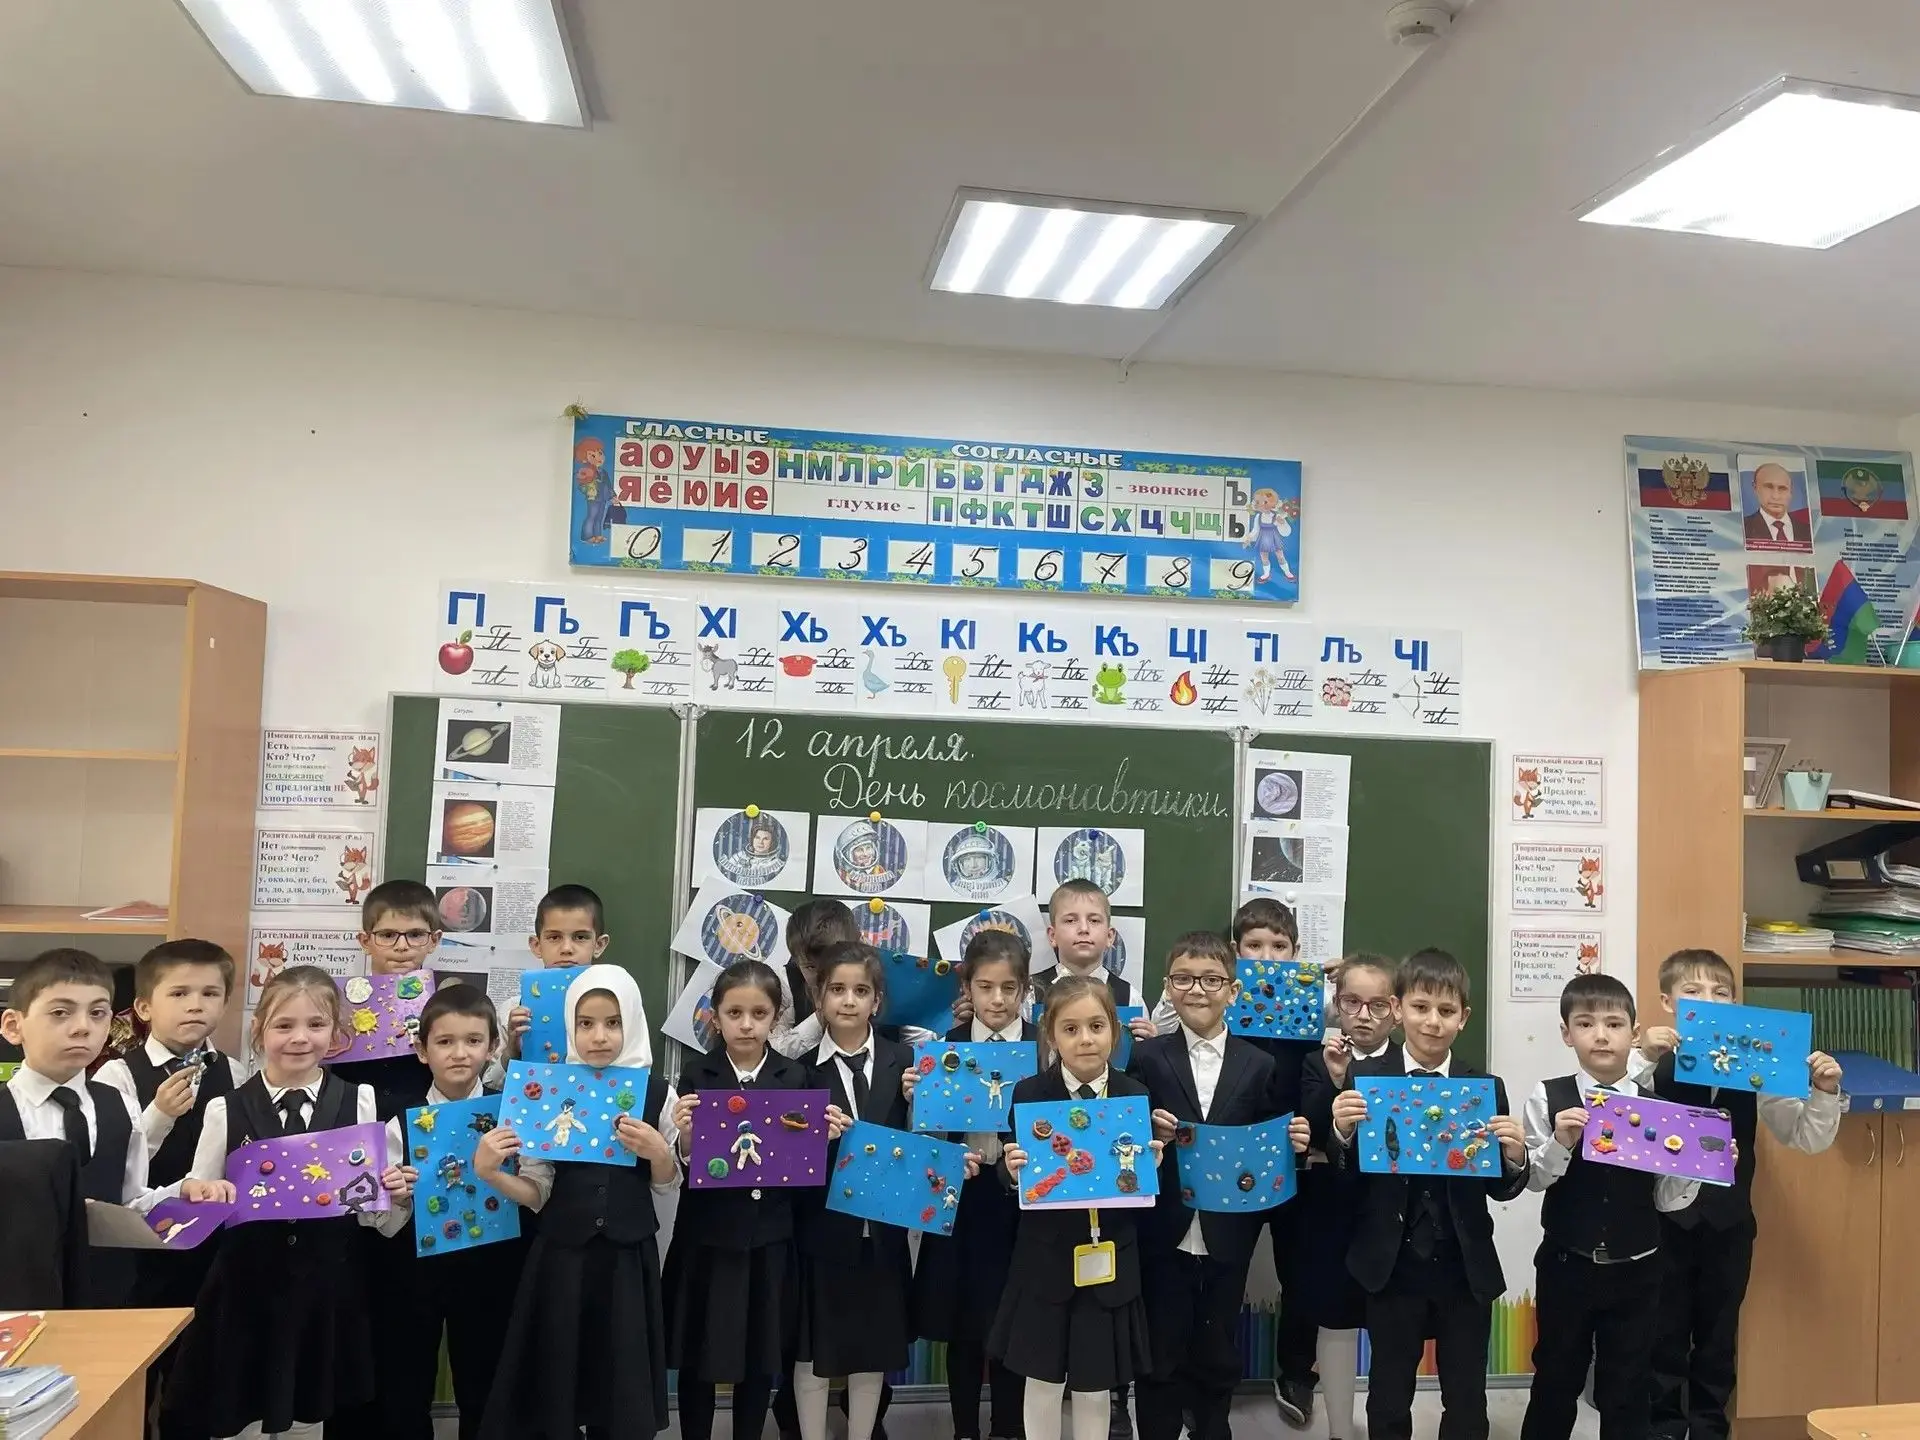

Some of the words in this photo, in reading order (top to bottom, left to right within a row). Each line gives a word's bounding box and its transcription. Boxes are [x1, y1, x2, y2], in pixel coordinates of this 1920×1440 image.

[626, 420, 769, 443] ГЛАСНЫЕ
[951, 444, 1123, 467] СОГЛАСНЫЕ
[1128, 484, 1209, 497] звонкие
[827, 499, 901, 512] глухие
[628, 526, 661, 559] 0
[712, 530, 731, 563] 1
[766, 534, 800, 567] 2
[838, 538, 867, 570] 3
[905, 543, 934, 574] 4
[961, 547, 999, 578] 5
[1034, 550, 1063, 581] 6
[1096, 553, 1126, 583] 7
[1164, 557, 1191, 588] 8
[1227, 560, 1255, 591] 9
[533, 596, 580, 634] Гь
[619, 601, 671, 640] Гъ
[780, 611, 829, 643] Хь
[860, 615, 907, 647] Хъ
[1018, 622, 1068, 653] Кь
[1095, 625, 1139, 657] Къ
[1320, 637, 1362, 663] Лъ
[266, 741, 289, 750] Есть
[736, 717, 785, 758] 12
[808, 730, 974, 777] апреля.
[266, 752, 290, 761] Кто?
[292, 753, 316, 762] Что?
[1543, 766, 1563, 774] Вижу
[1543, 776, 1565, 784] Кого?
[1567, 776, 1586, 785] Что?
[265, 782, 273, 791] С
[275, 784, 331, 792] предлогами
[824, 763, 925, 809] День
[944, 757, 1228, 817] космонавтики.
[1543, 786, 1587, 796] Предлоги:
[264, 794, 334, 804] употребляется
[260, 841, 278, 850] Нет
[260, 853, 288, 862] Кого?
[291, 853, 319, 862] Чего?
[259, 863, 309, 873] Предлоги:
[1515, 874, 1557, 883] Предлоги:
[254, 930, 309, 940] Дательный
[312, 932, 341, 941] падеж
[292, 942, 316, 952] Дать
[1513, 940, 1540, 949] Думаю
[292, 954, 323, 963] Кому?
[326, 954, 356, 964] Чему?
[1513, 960, 1556, 970] Предлоги:
